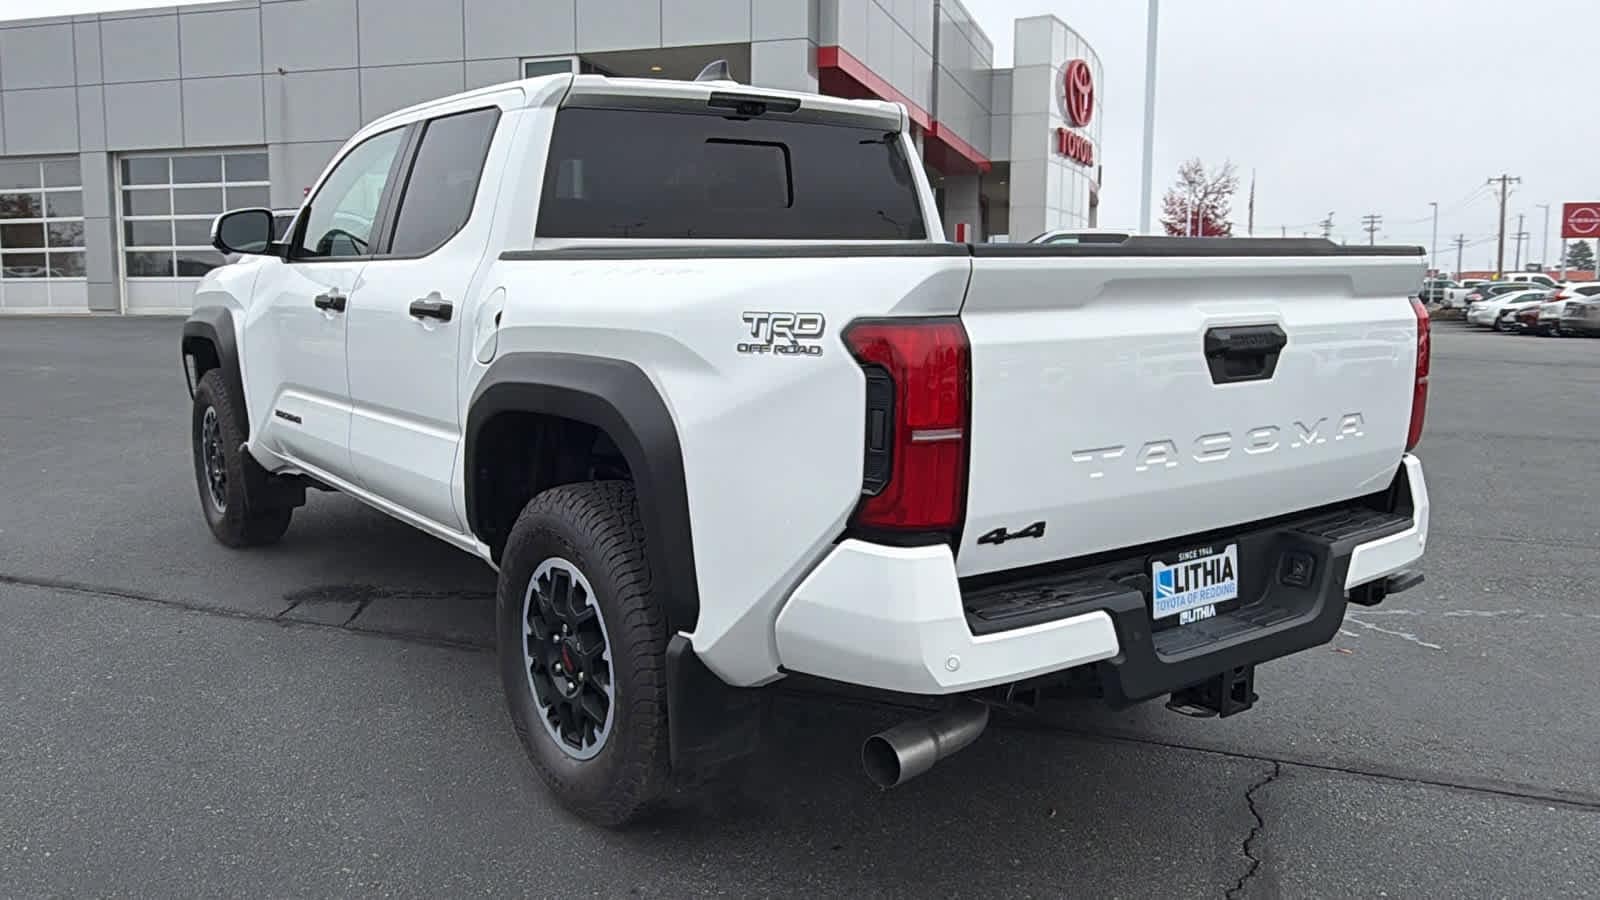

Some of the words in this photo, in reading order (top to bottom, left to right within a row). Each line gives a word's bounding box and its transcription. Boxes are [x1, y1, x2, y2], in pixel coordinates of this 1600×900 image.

[1056, 128, 1093, 168] TOYOTA
[743, 311, 825, 345] TRD
[737, 343, 771, 353] OFF
[773, 344, 823, 356] ROAD
[1072, 412, 1365, 478] TACOMA
[1178, 550, 1197, 561] SINCE
[1174, 556, 1234, 593] LITHIA
[1156, 594, 1186, 611] TOYOTA
[1187, 592, 1198, 604] OF
[1200, 583, 1235, 600] REDDING
[1188, 604, 1216, 622] LITHIA
